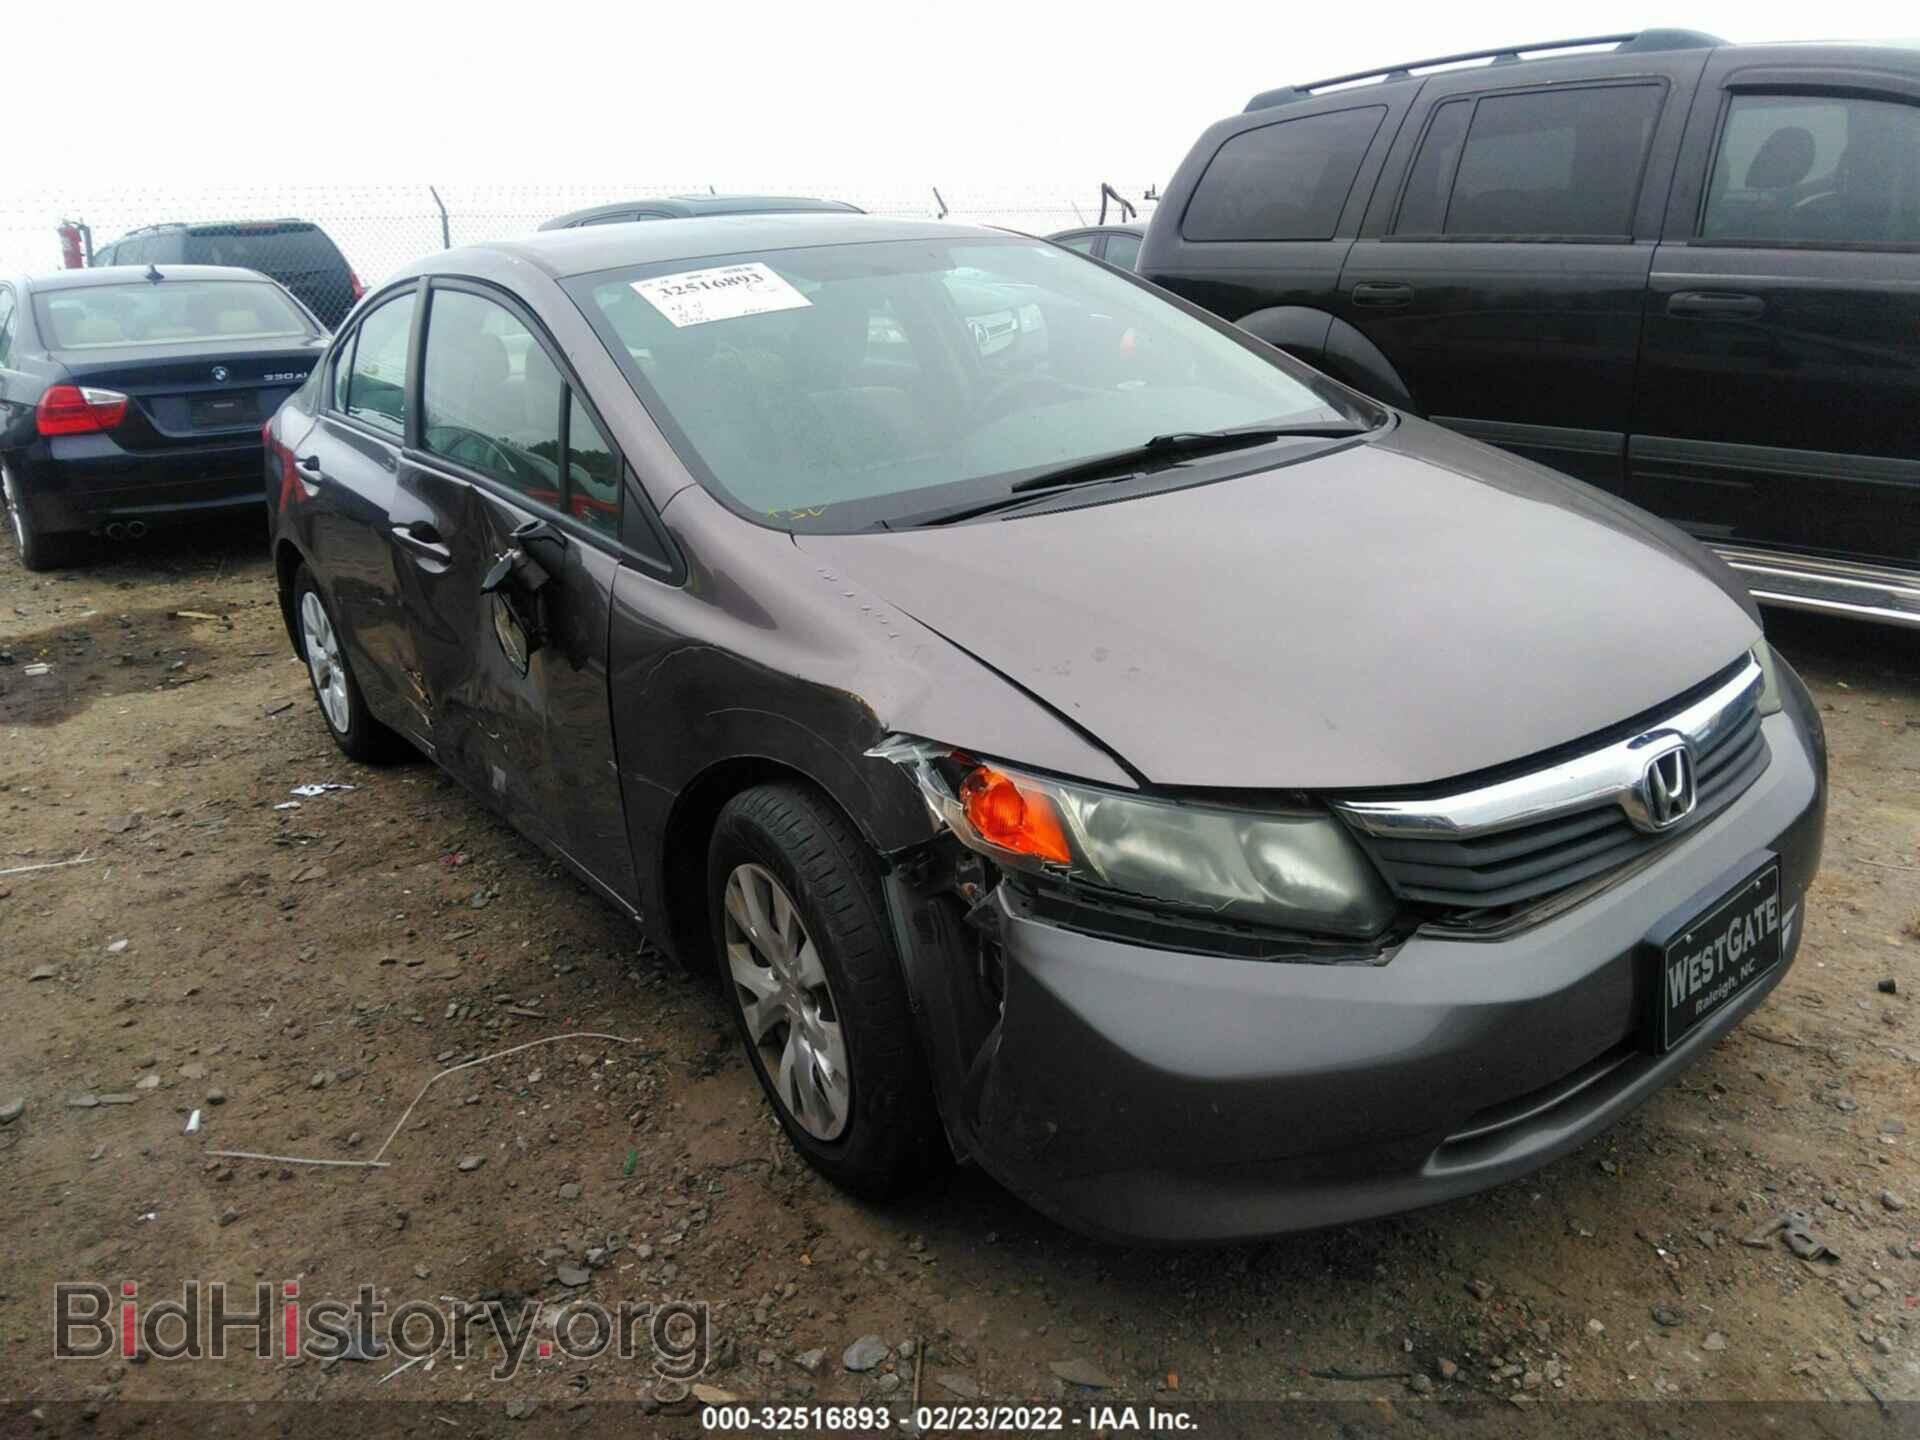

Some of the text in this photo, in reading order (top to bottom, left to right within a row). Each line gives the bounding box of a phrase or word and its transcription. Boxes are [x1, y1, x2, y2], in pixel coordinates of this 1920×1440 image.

[657, 272, 765, 298] 32516893
[1668, 896, 1780, 1008] WESTGATE
[1740, 957, 1757, 980] NC
